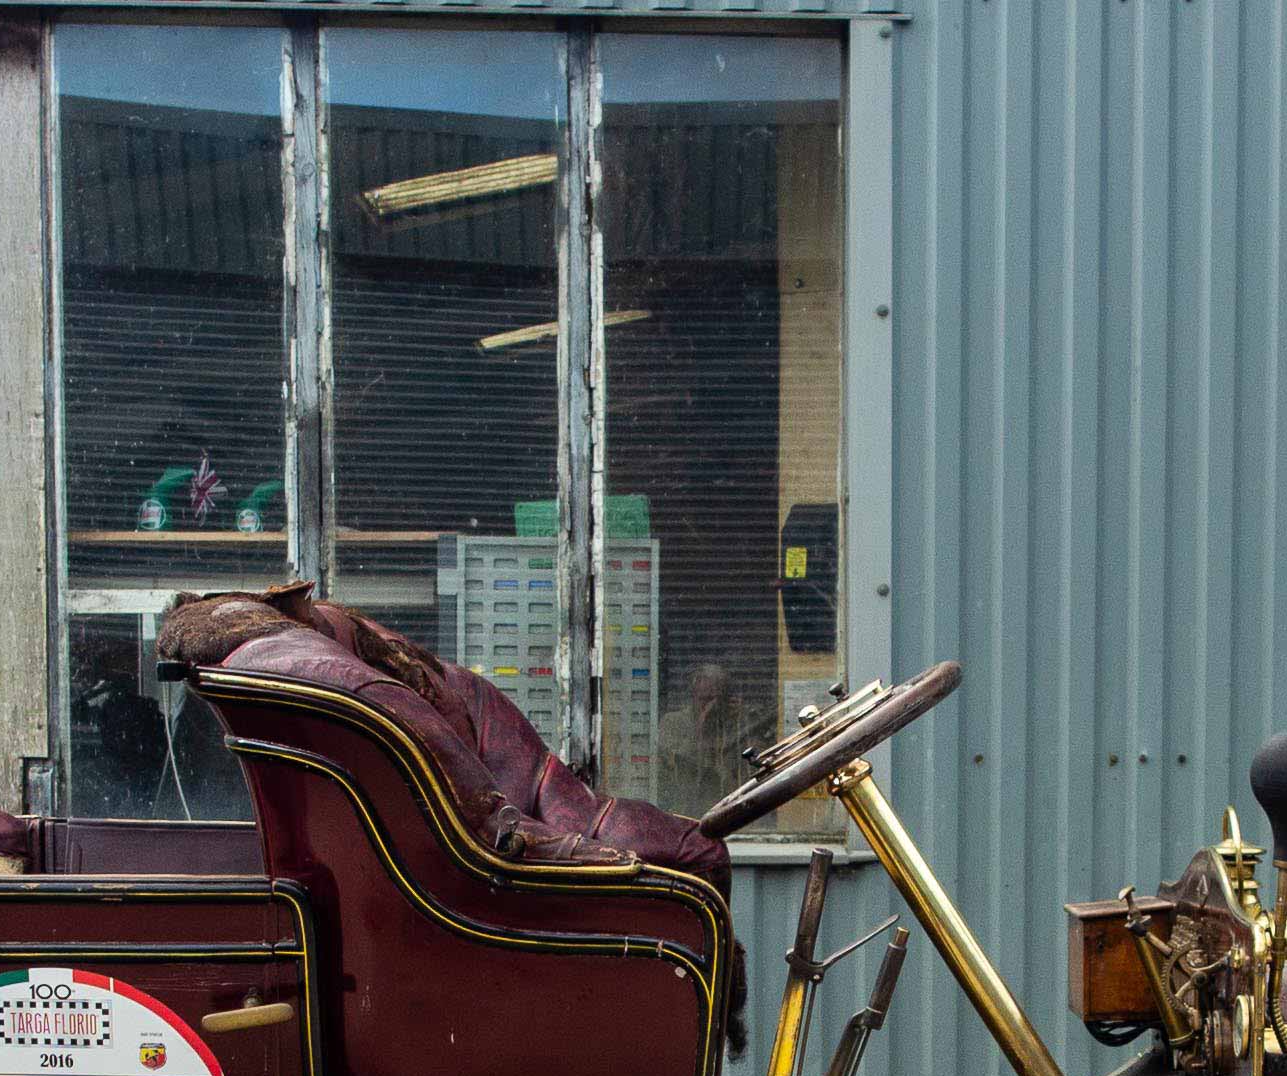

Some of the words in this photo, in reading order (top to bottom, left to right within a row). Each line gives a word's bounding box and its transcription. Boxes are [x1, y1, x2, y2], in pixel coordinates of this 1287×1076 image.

[29, 983, 72, 1000] 100
[10, 1012, 50, 1034] TARGA
[54, 1012, 97, 1035] FLORIO
[39, 1053, 74, 1068] 2016
